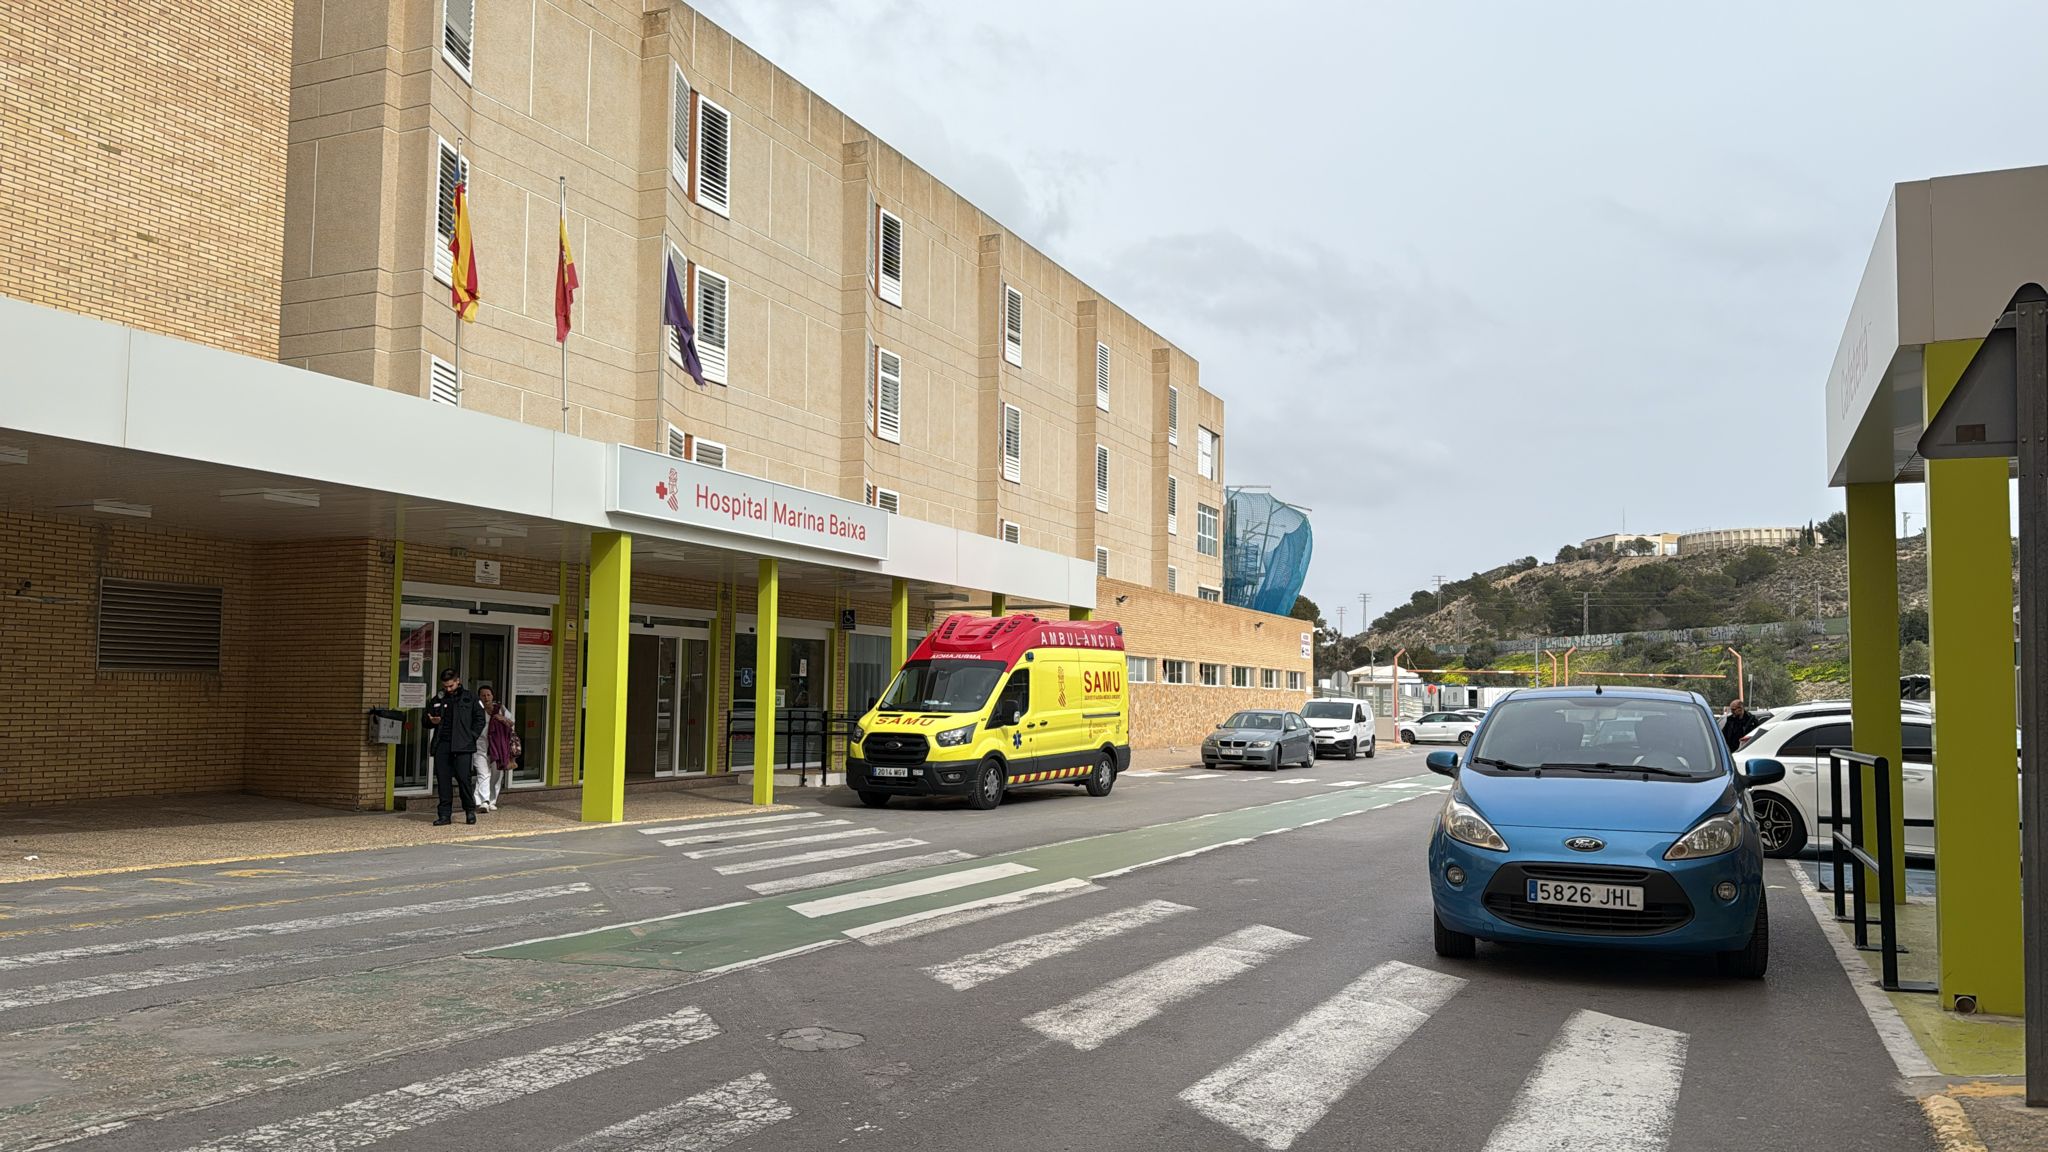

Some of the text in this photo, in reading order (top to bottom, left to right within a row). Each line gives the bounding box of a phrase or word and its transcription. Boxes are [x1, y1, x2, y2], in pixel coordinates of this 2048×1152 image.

[696, 483, 867, 541] Hospital Marina Baixa
[1041, 630, 1116, 648] AMBULÀNCIA
[1083, 670, 1121, 693] SAMU
[875, 717, 935, 727] SAMU
[1573, 839, 1596, 849] Ford
[1539, 883, 1592, 904] 5826
[1599, 887, 1638, 908] JHL
